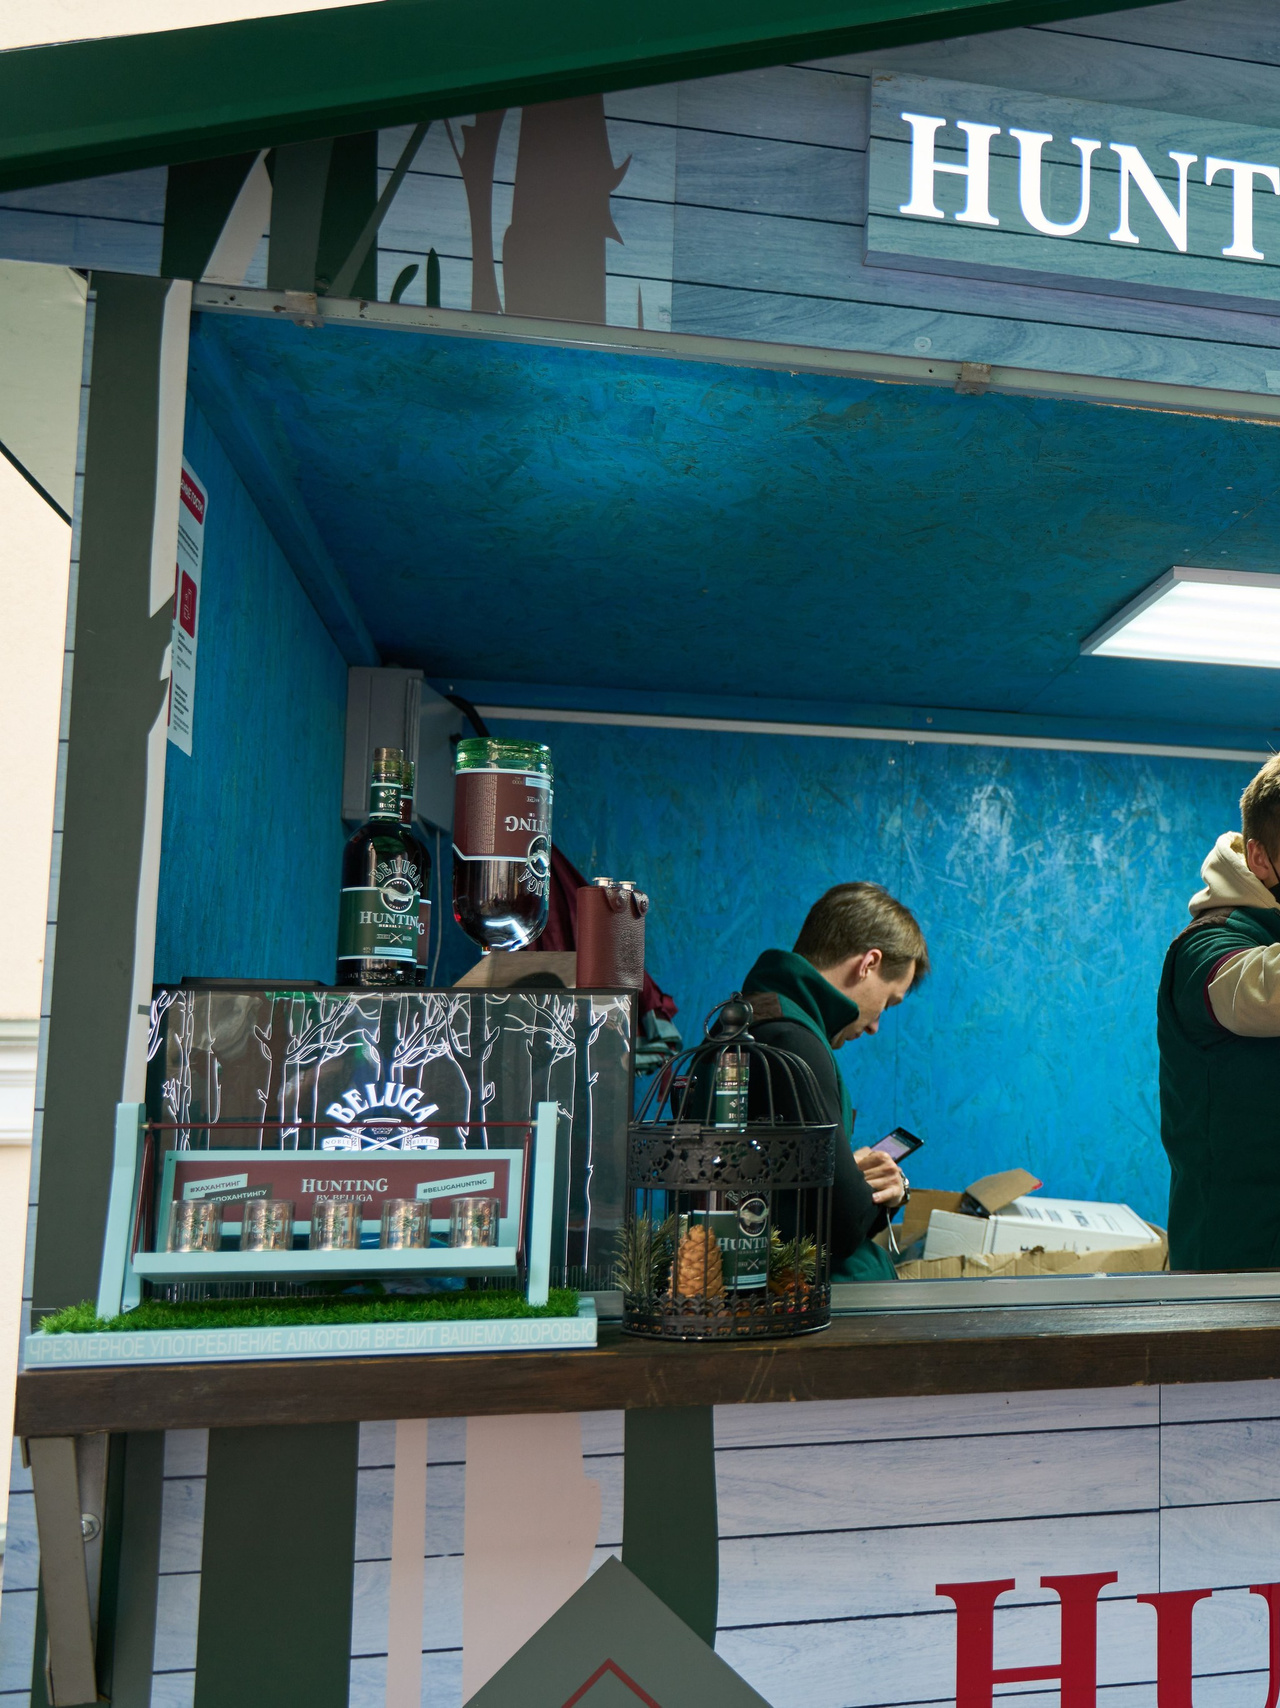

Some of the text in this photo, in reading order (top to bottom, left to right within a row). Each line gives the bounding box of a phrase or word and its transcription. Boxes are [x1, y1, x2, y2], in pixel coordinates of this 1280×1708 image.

[325, 1082, 440, 1124] BELUGA
[190, 1180, 241, 1193] #ХАХАНТИНГ
[301, 1177, 389, 1193] HUNTING
[422, 1178, 488, 1194] #BELUGAHUNTING
[332, 1194, 373, 1202] BELUGA
[28, 1321, 596, 1362] ЧРЕЗМЕРНОЕ УПОТРЕБЛЕНИЕ АЛКОГОЛЯ ВРЕДИТ ВАШЕМУ ЗДОРОВЬЮ
